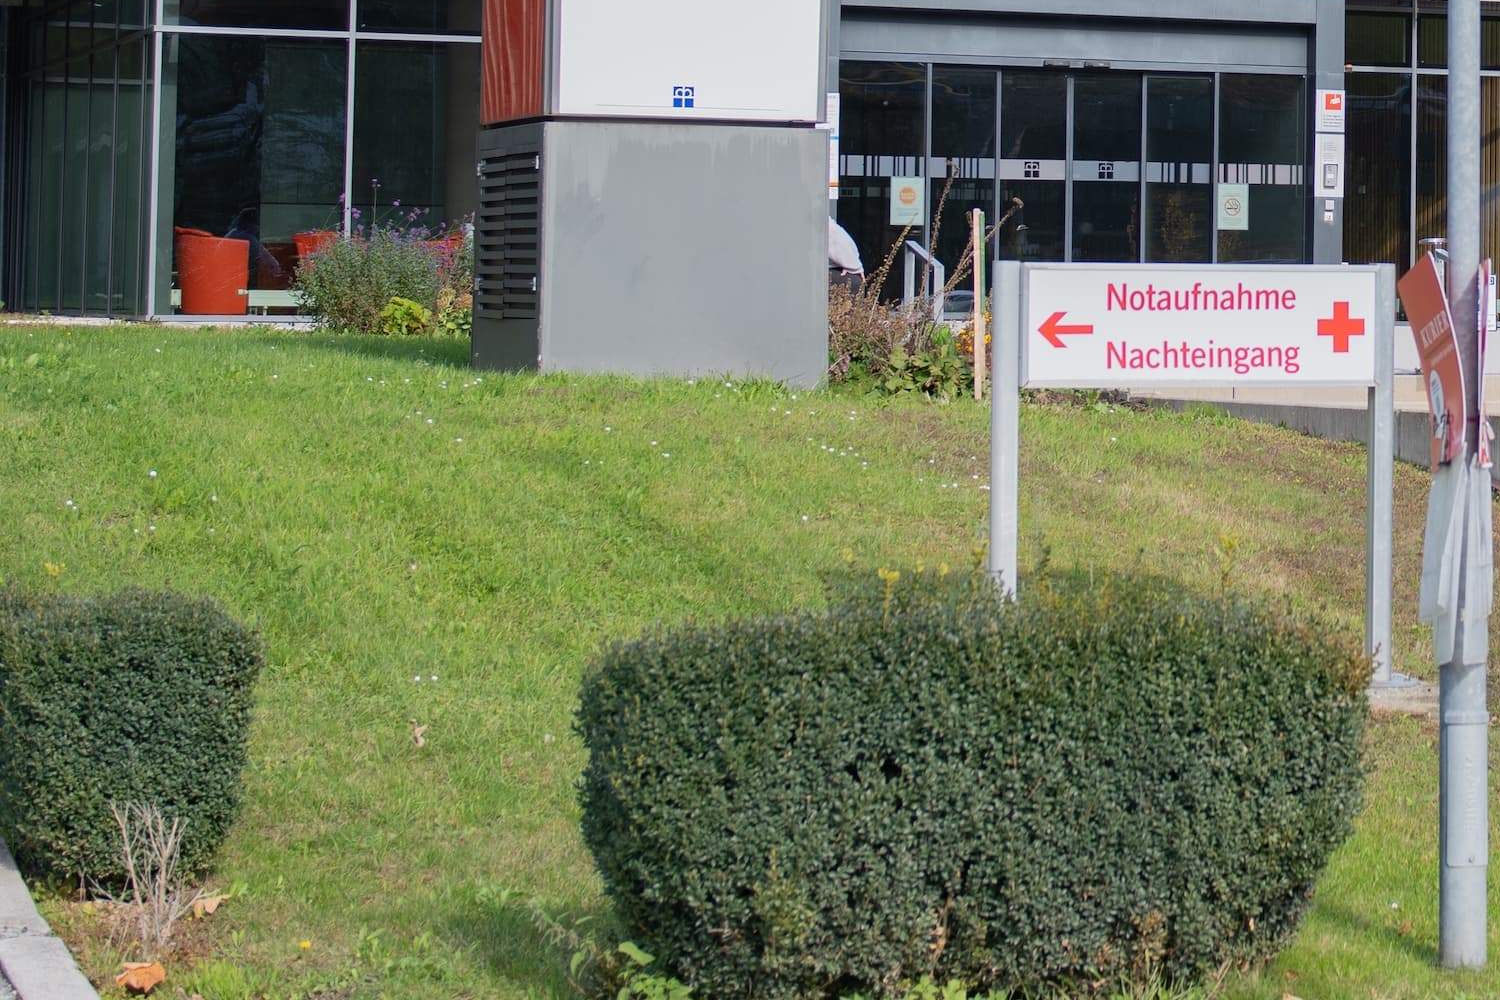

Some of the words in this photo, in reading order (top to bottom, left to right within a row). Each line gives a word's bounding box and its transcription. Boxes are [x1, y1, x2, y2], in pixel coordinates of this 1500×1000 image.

[1106, 282, 1297, 312] Notaufnahme
[1420, 310, 1449, 349] KURIER
[1106, 339, 1301, 375] Nachteingang
